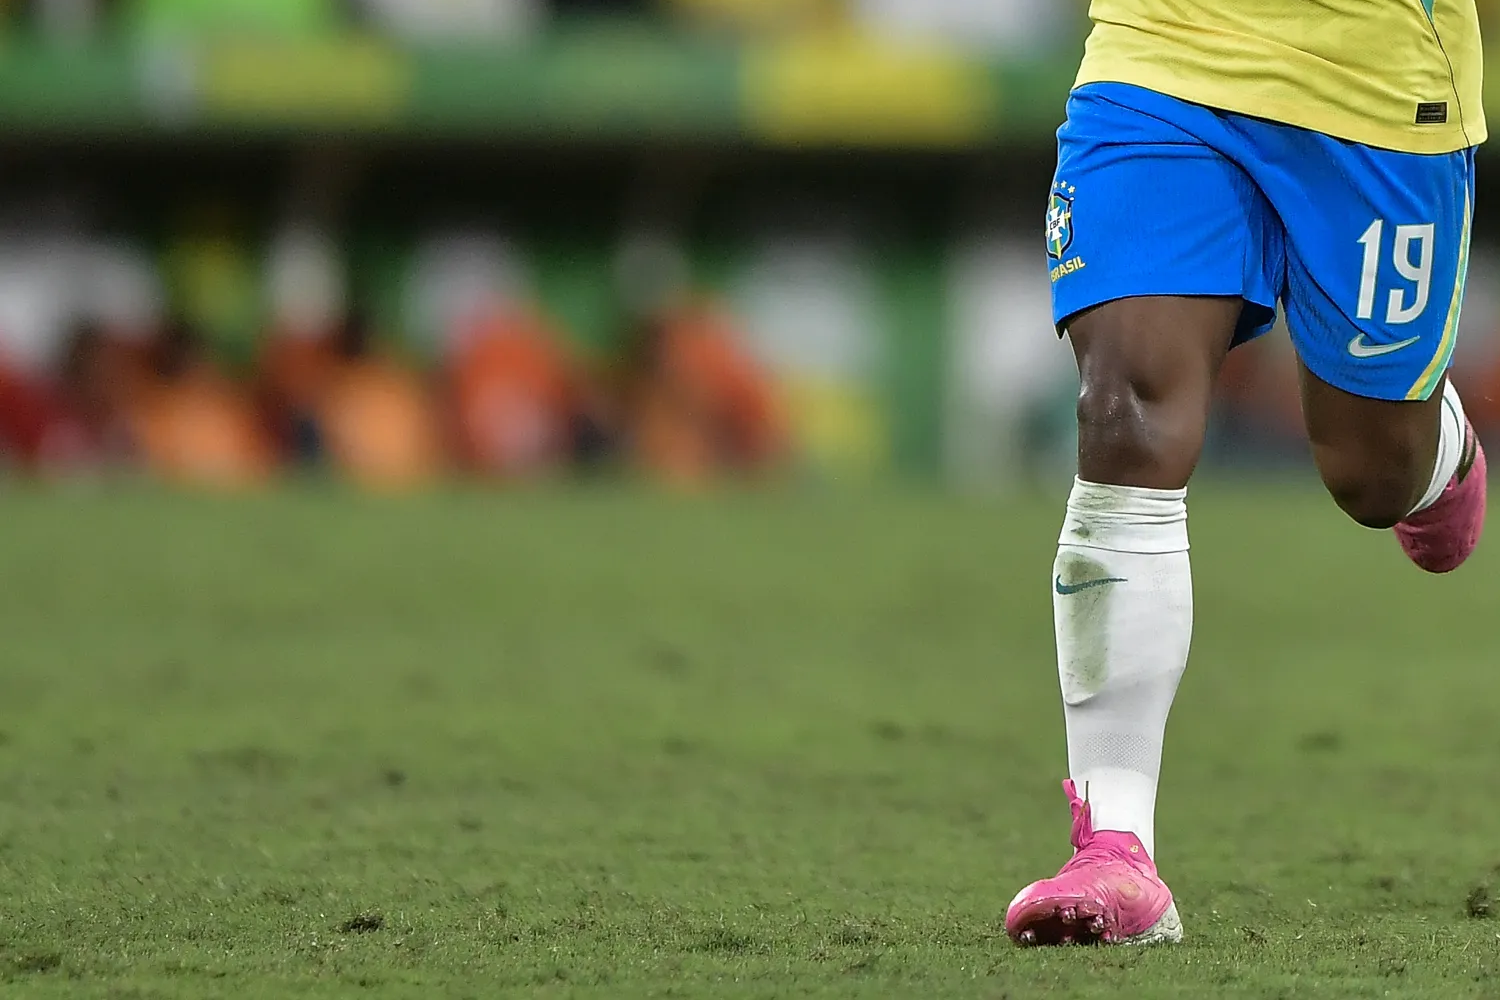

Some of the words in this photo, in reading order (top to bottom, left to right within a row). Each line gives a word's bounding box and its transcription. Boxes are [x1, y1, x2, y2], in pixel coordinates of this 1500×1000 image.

[1049, 218, 1061, 231] CBF
[1050, 256, 1086, 283] BRASIL
[1356, 219, 1435, 325] 19
